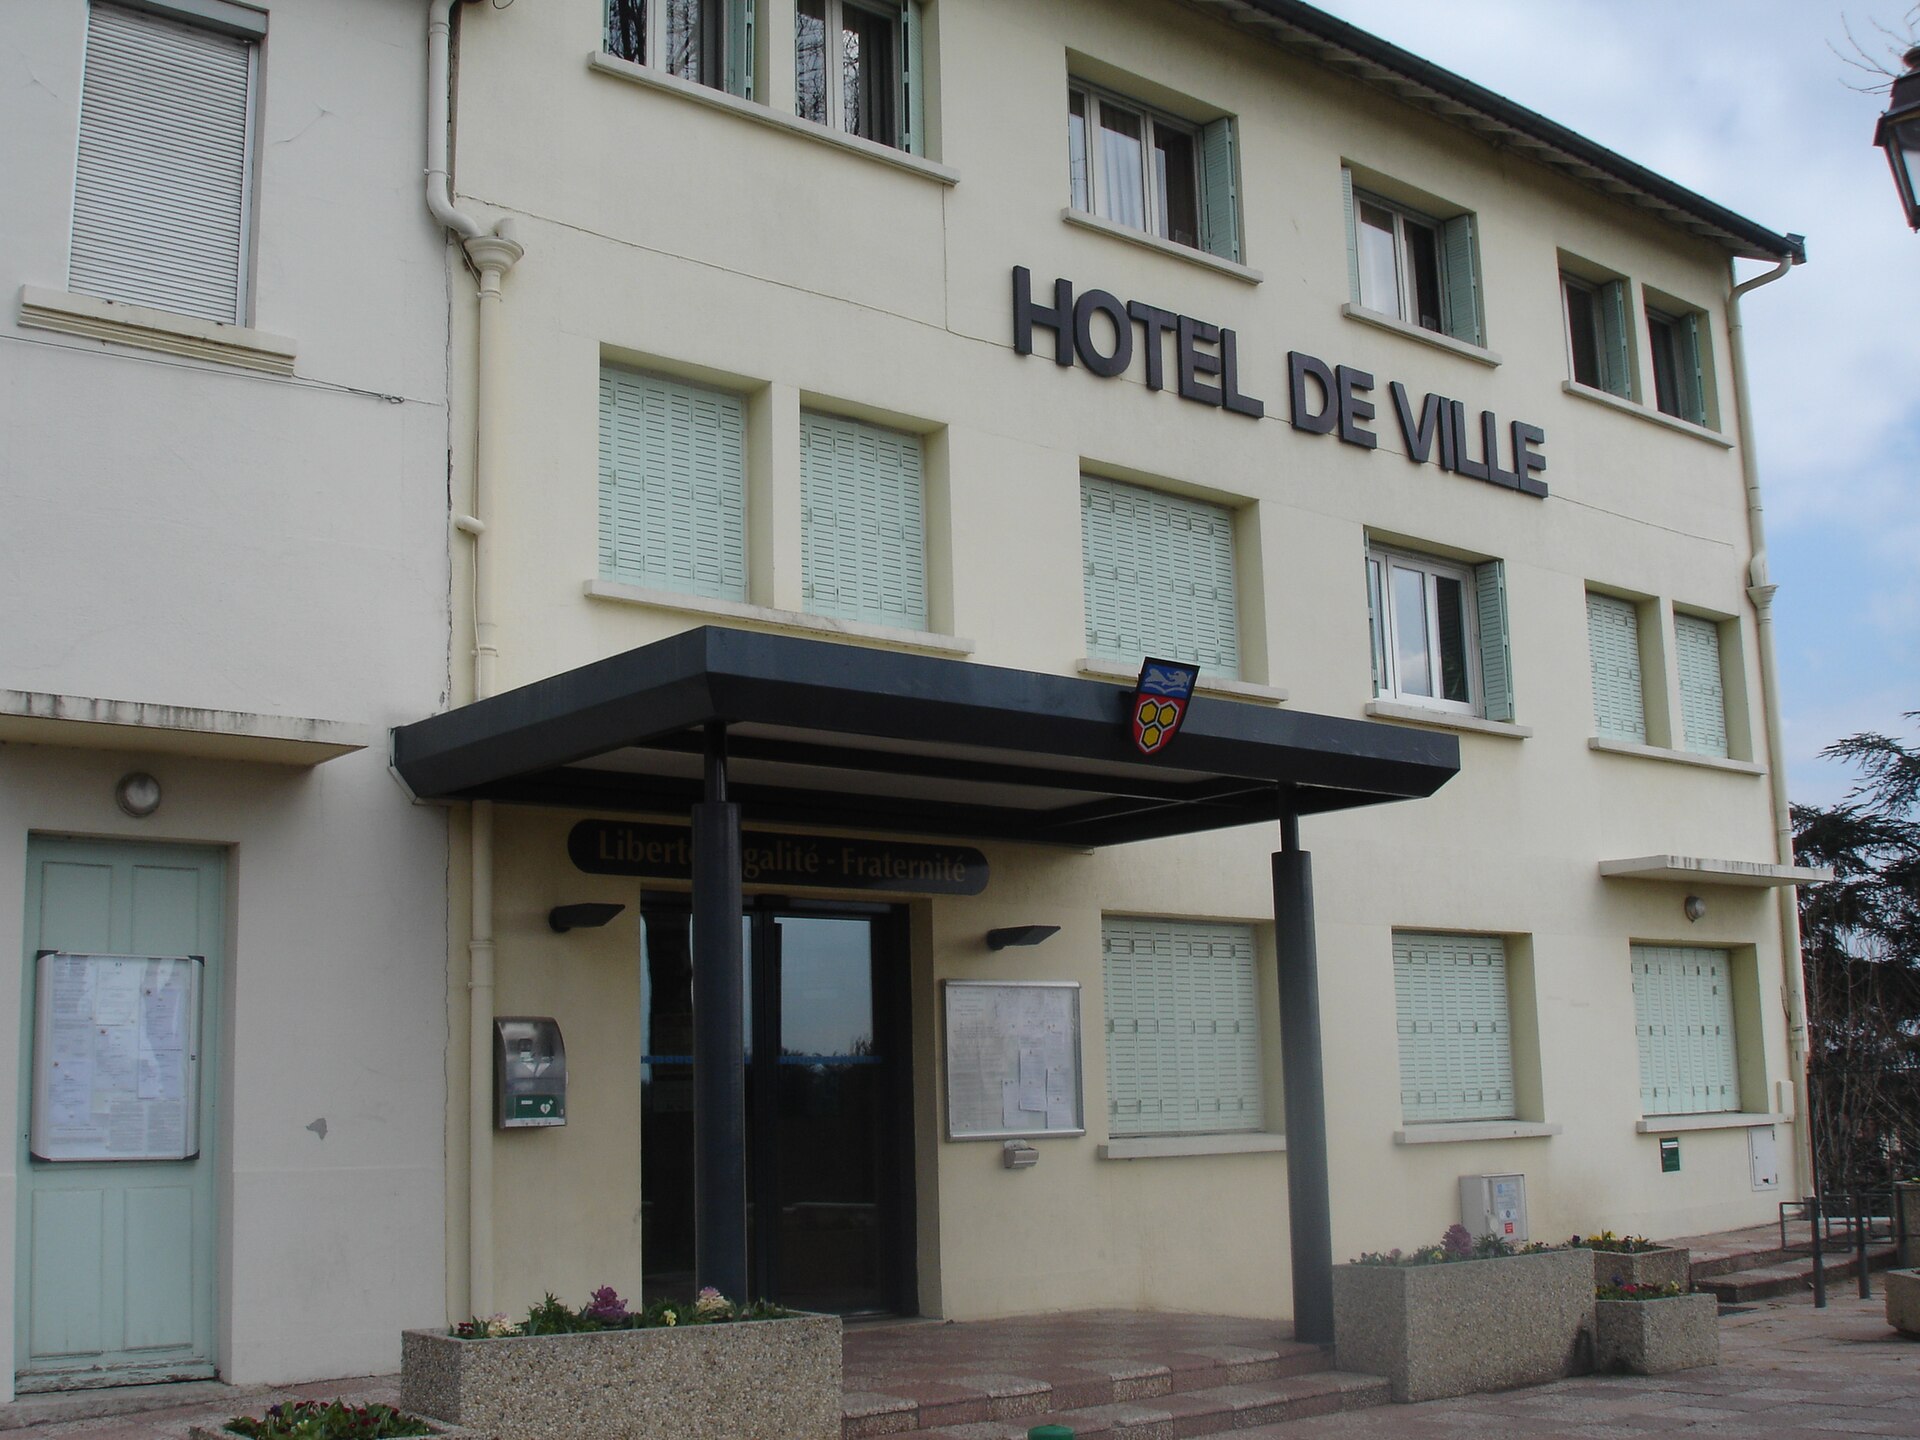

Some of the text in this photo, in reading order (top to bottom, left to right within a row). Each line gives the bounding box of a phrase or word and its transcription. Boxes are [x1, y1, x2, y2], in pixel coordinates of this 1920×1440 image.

[1012, 265, 1549, 499] HOTEL DE VILLE
[742, 841, 820, 879] galité
[842, 847, 967, 883] Fraternité
